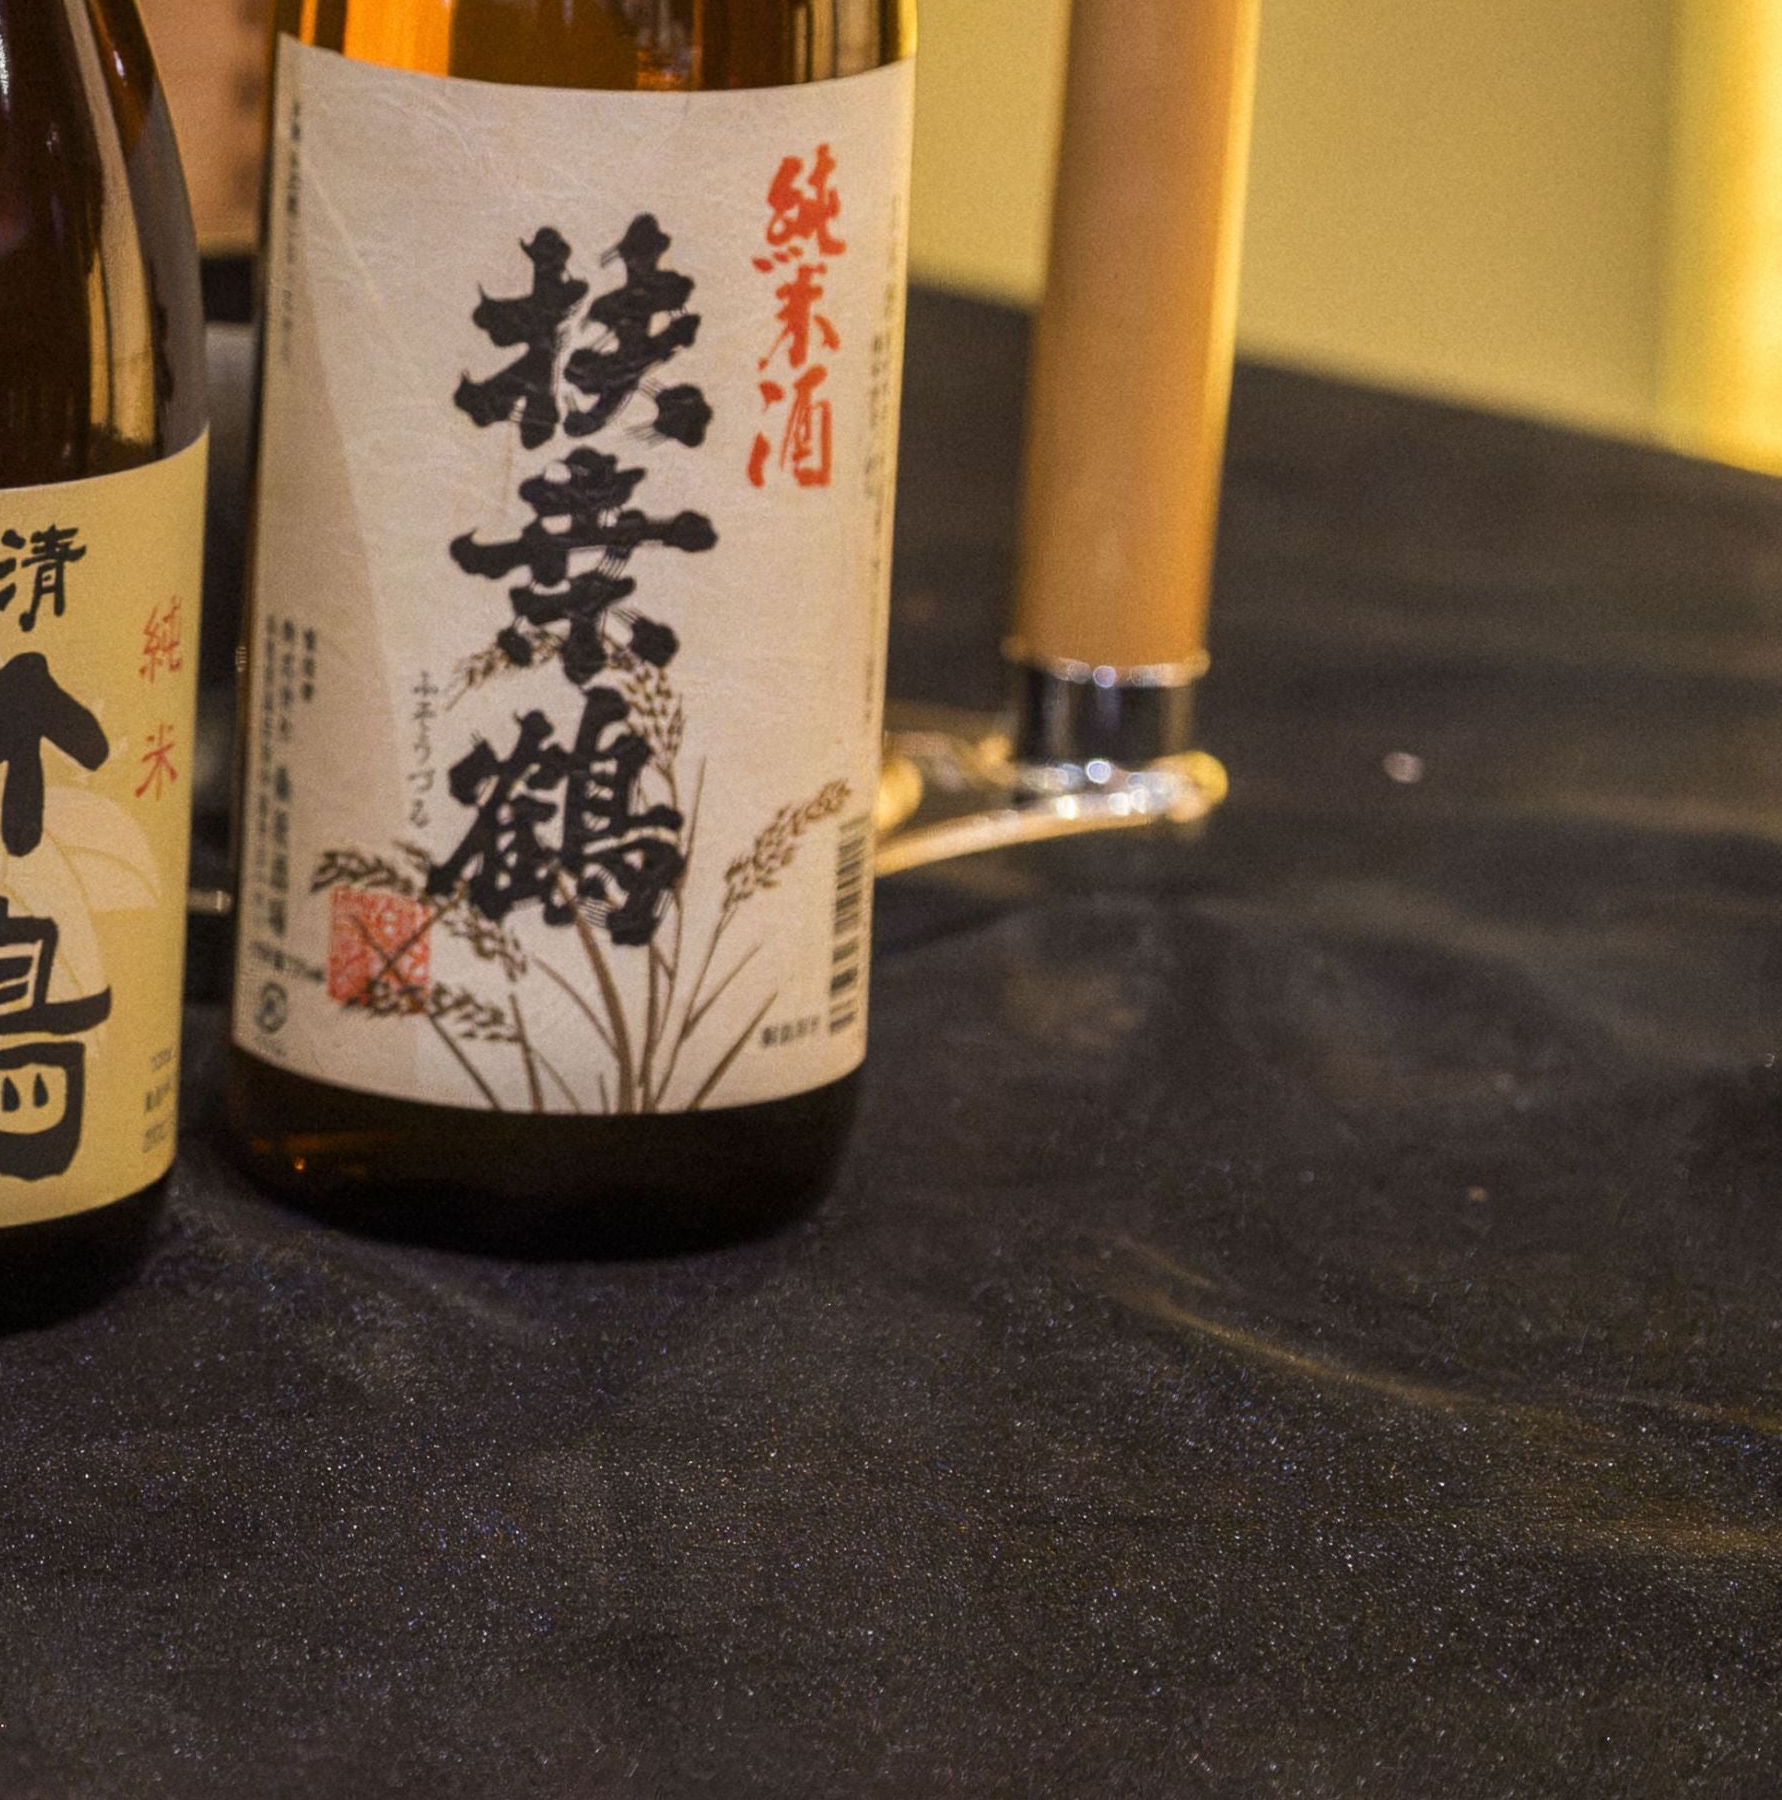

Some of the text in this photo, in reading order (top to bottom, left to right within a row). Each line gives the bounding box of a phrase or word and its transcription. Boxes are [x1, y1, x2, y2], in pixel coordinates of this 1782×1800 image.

[746, 142, 847, 490] 純米酒
[134, 593, 185, 802] 純米
